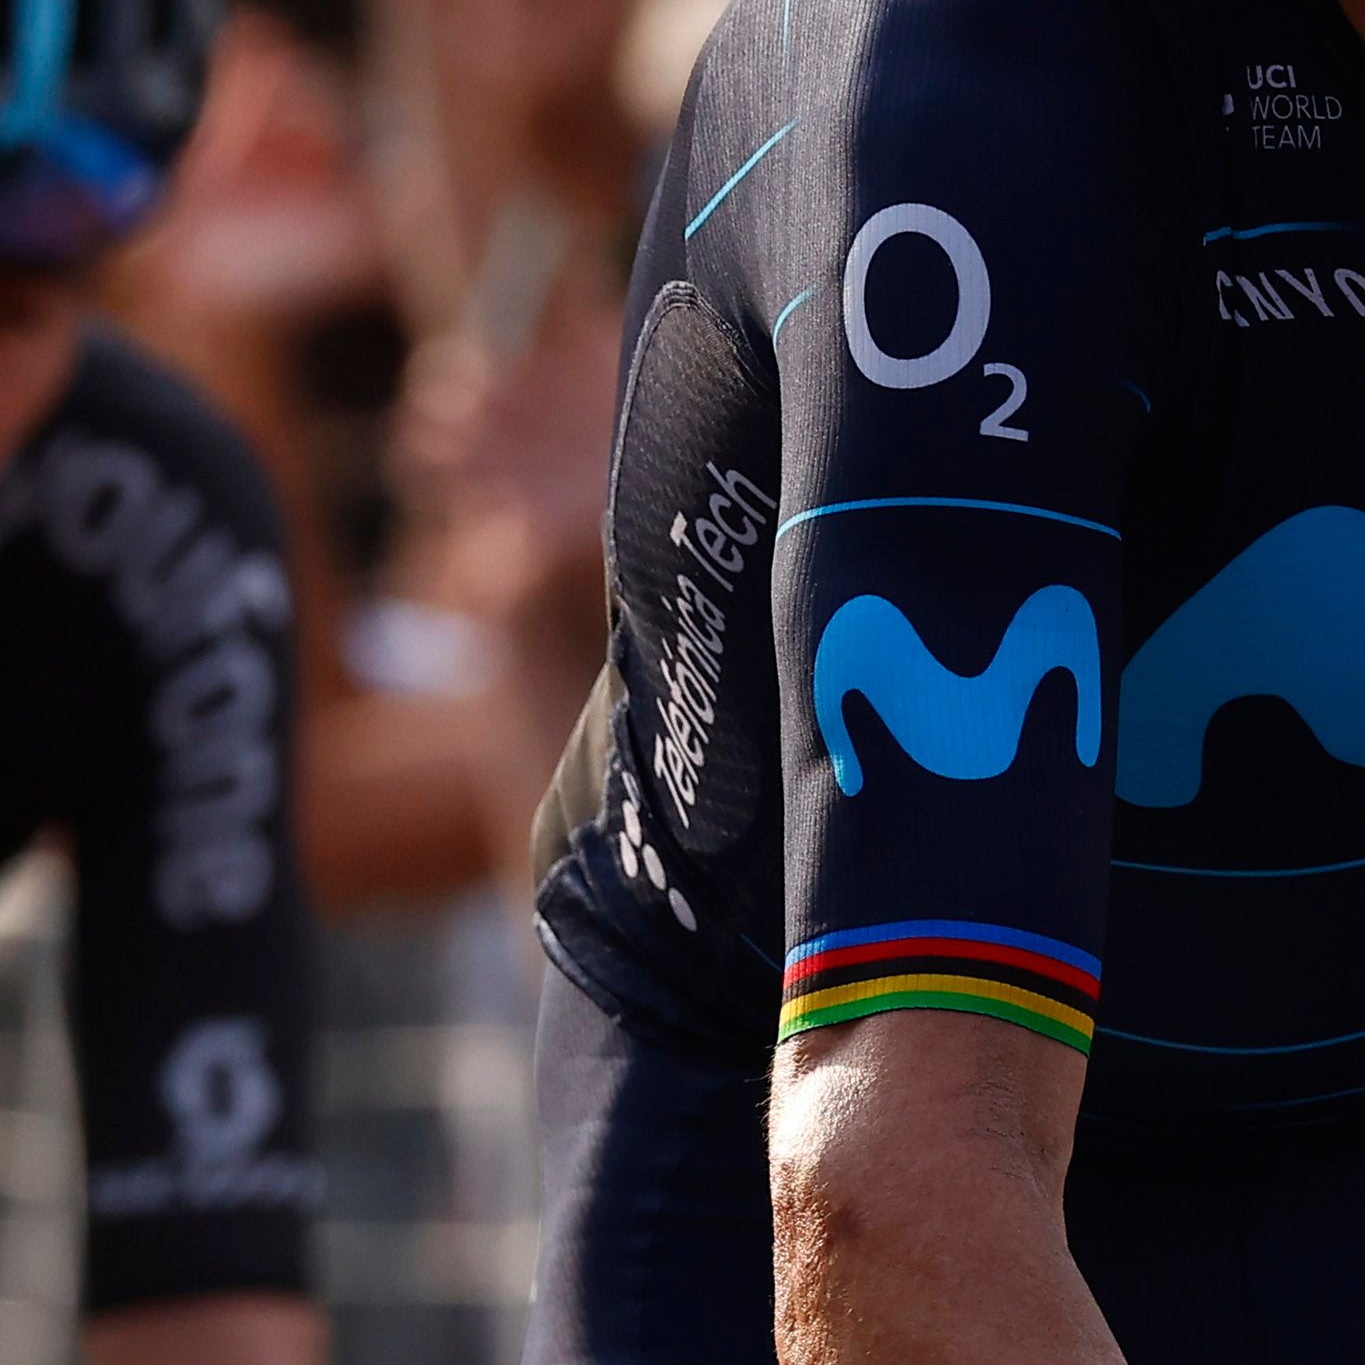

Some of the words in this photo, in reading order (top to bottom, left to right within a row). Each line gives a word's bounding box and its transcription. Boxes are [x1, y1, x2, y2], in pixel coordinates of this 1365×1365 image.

[1247, 65, 1297, 89] UCI
[1251, 94, 1343, 120] WORLD
[1252, 125, 1322, 150] TEAM
[670, 460, 777, 592] Tech
[653, 574, 726, 829] Telefónica
